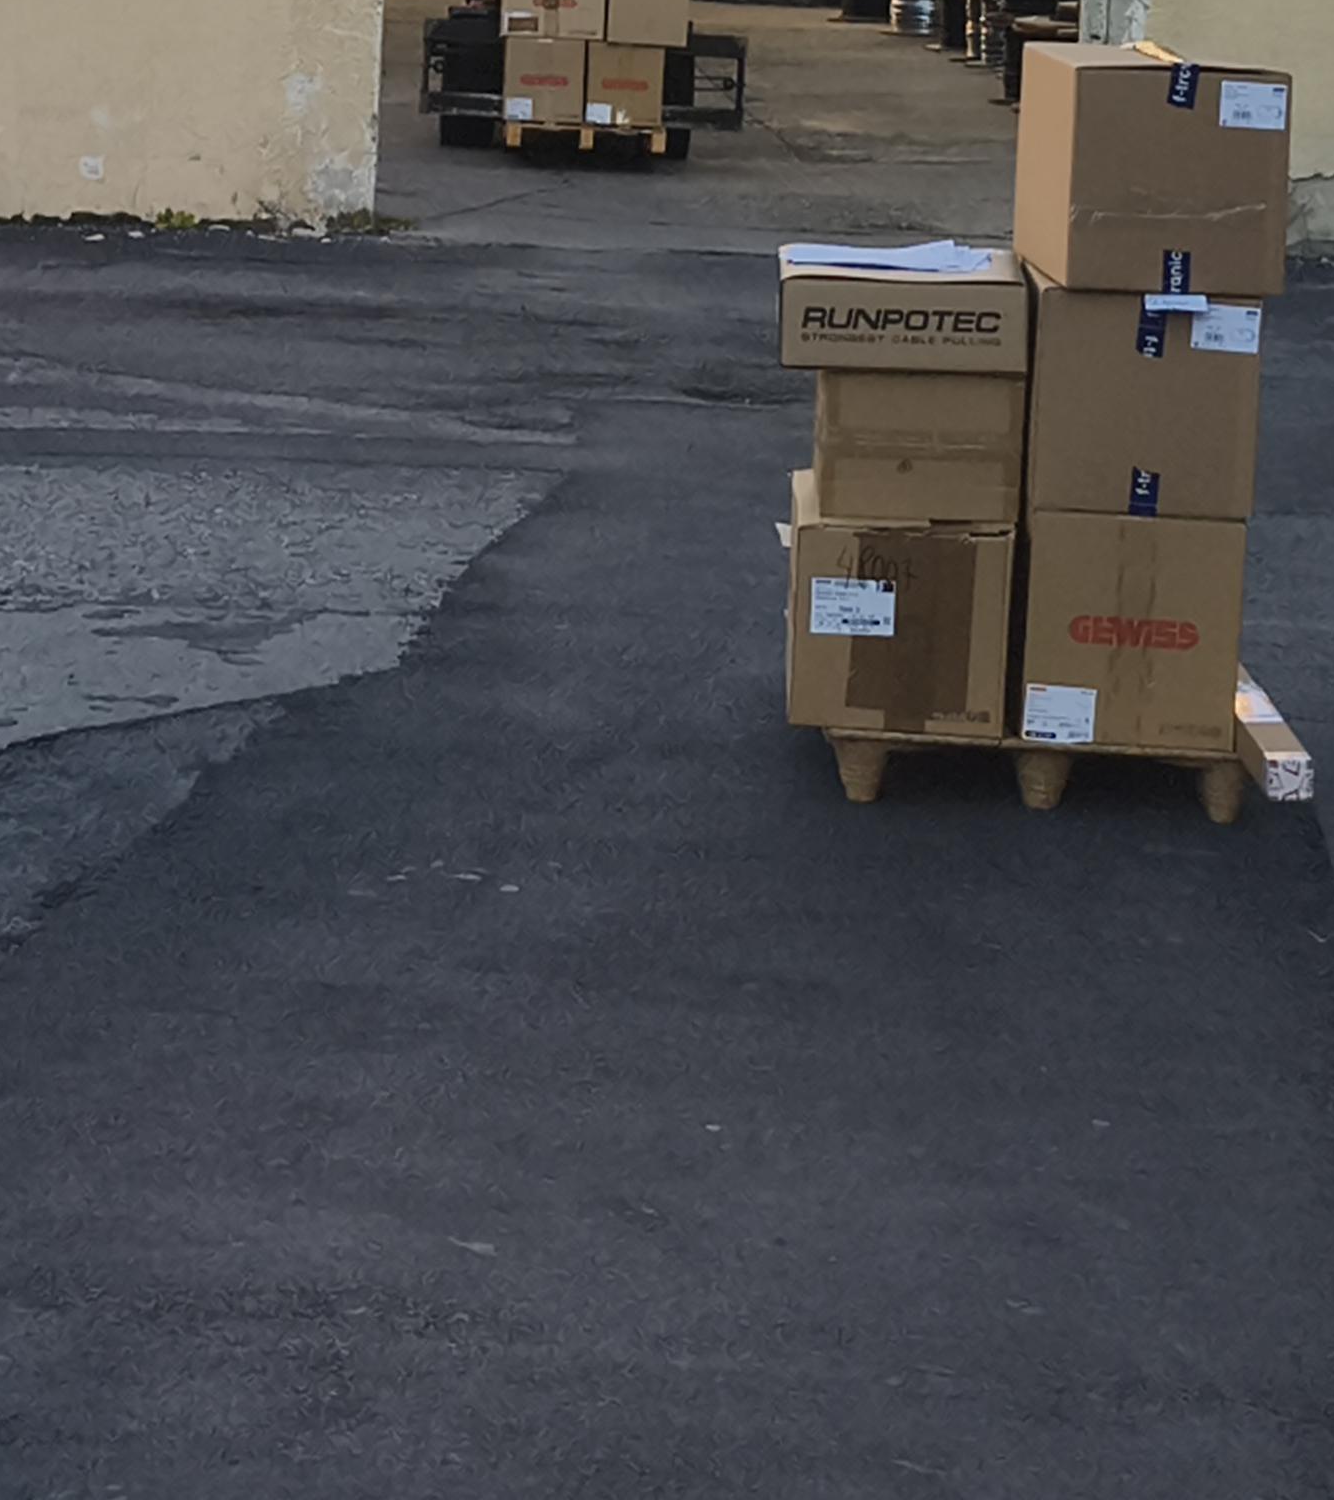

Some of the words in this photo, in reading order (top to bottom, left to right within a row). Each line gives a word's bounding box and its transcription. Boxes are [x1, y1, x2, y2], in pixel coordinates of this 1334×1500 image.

[801, 307, 1001, 333] RUNPOTEC
[892, 335, 935, 345] CABLE
[942, 336, 1001, 347] PULLING
[1069, 614, 1200, 651] GEWISS
